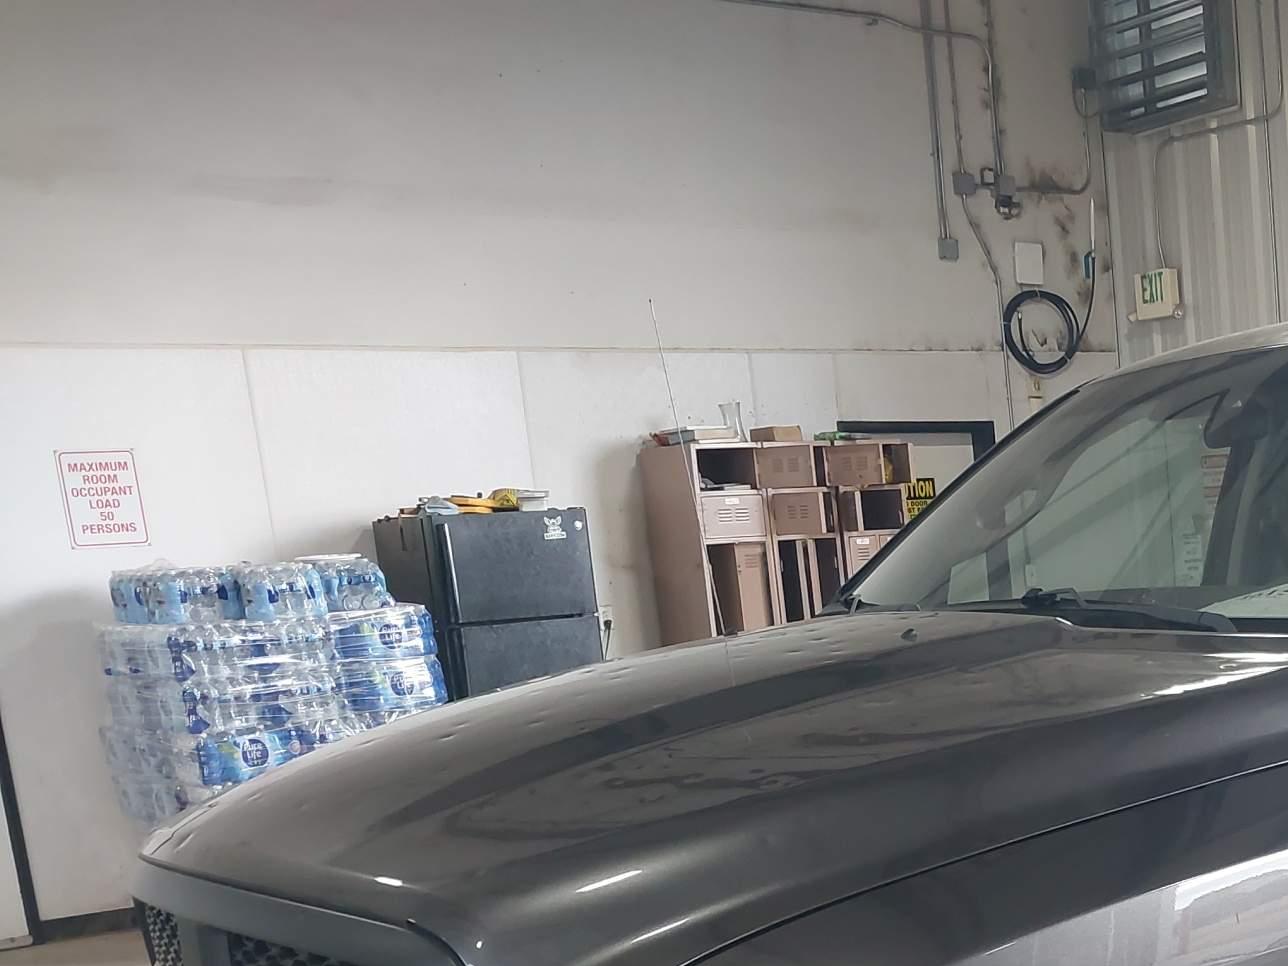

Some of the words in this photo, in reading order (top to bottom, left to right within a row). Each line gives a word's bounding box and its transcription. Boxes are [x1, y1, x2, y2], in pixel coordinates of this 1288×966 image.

[1141, 271, 1164, 304] EXIT
[67, 461, 128, 472] MAXIMUM
[82, 474, 118, 485] ROOM
[71, 486, 133, 497] OCCUPANT
[88, 499, 120, 509] LOAD
[99, 511, 114, 521] 50
[81, 522, 137, 534] PERSONS
[247, 750, 262, 761] Life
